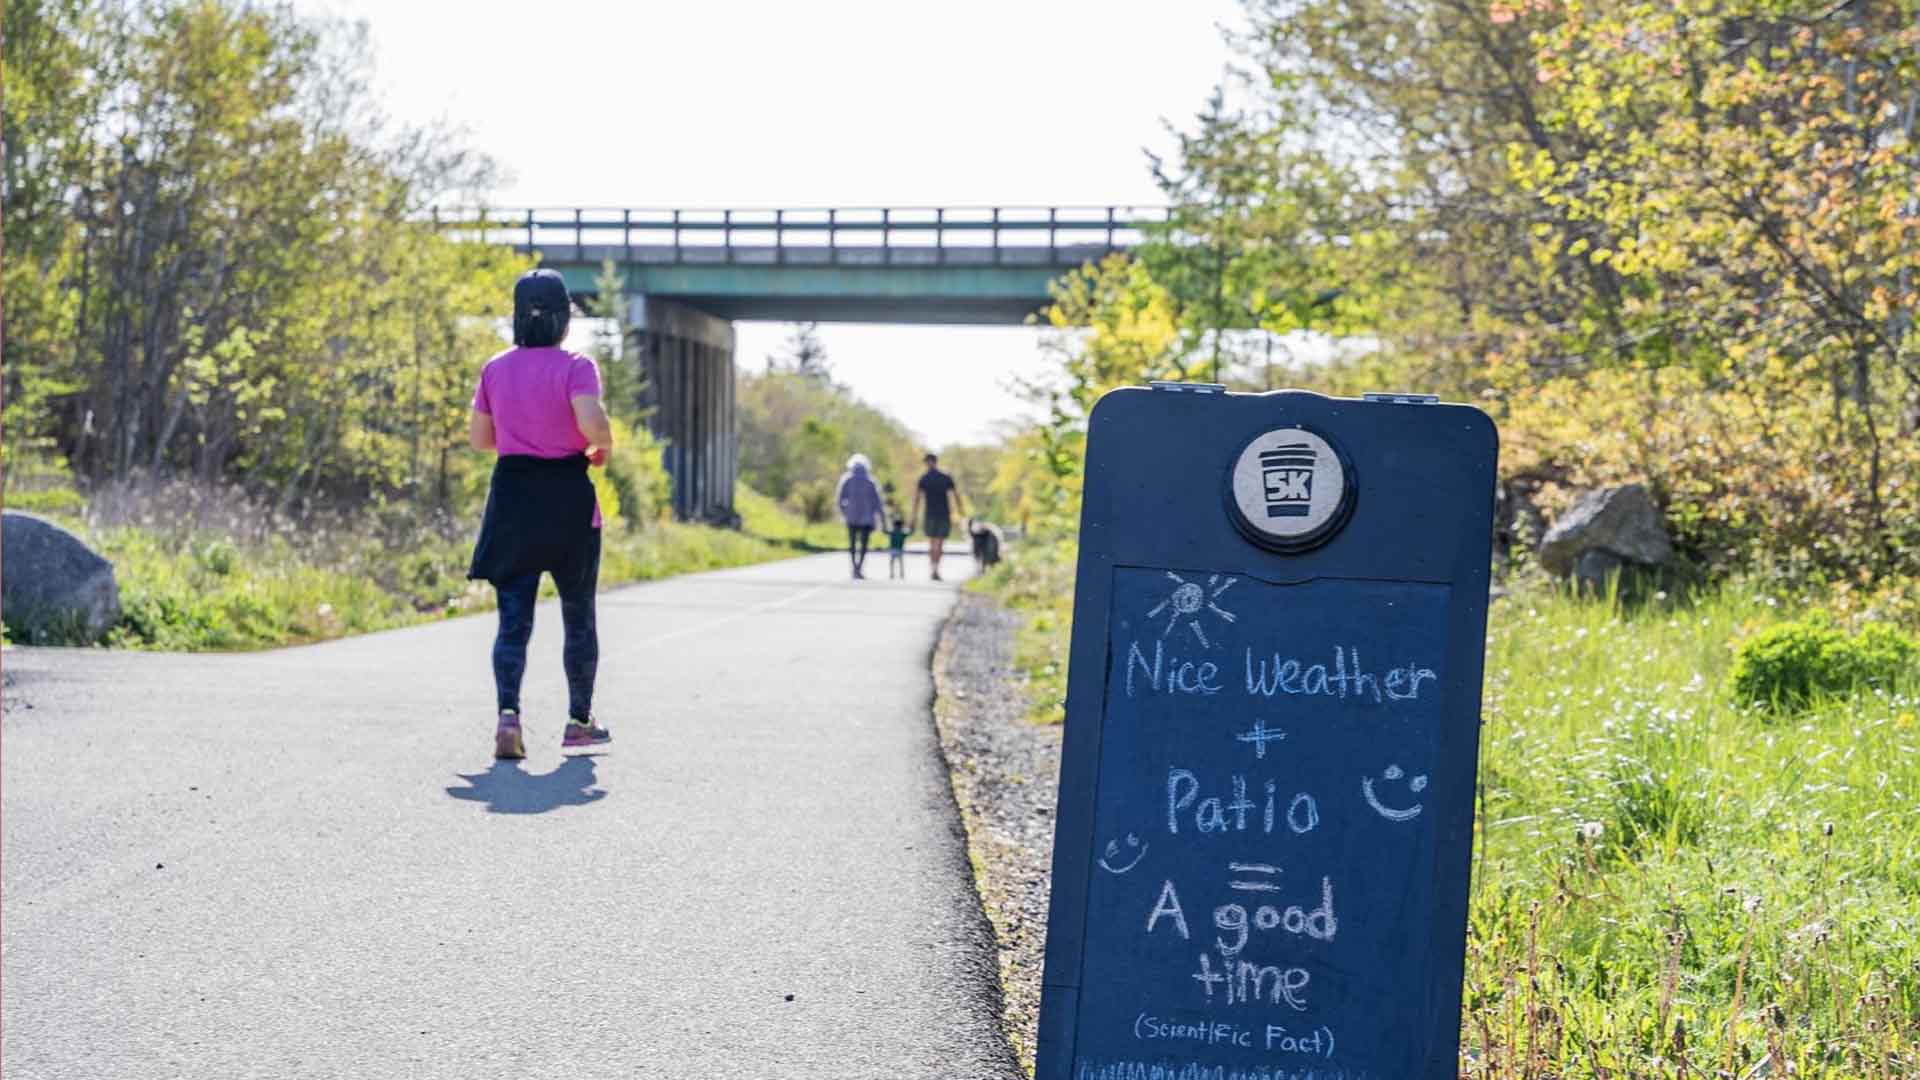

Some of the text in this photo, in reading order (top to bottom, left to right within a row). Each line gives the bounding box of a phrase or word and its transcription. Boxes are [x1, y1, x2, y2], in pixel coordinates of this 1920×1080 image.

[1263, 470, 1312, 501] 5K
[1125, 639, 1437, 702] Nice Weather
[1167, 765, 1320, 834] Patio
[1146, 874, 1338, 956] A good
[1191, 952, 1311, 1012] time
[1265, 1023, 1335, 1059] Fact)
